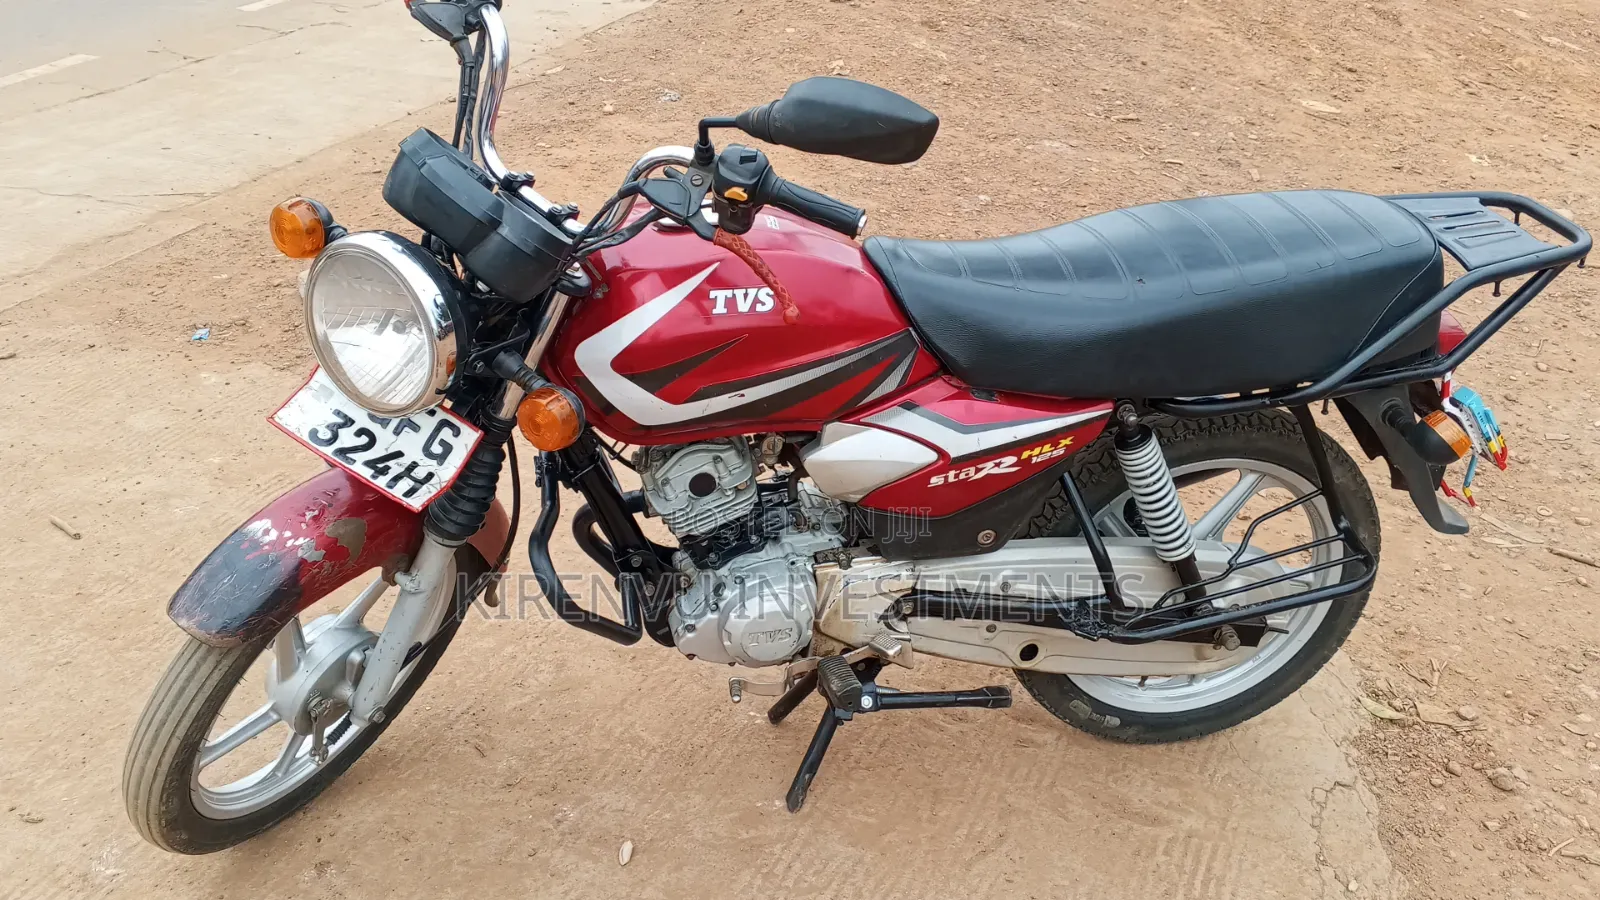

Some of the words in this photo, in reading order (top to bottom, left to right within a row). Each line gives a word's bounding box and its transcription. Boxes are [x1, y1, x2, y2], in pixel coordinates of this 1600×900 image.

[708, 287, 776, 315] TVS
[308, 408, 435, 498] 324H
[1020, 435, 1075, 460] HLX
[1030, 447, 1067, 464] 125
[748, 627, 793, 646] TVS
